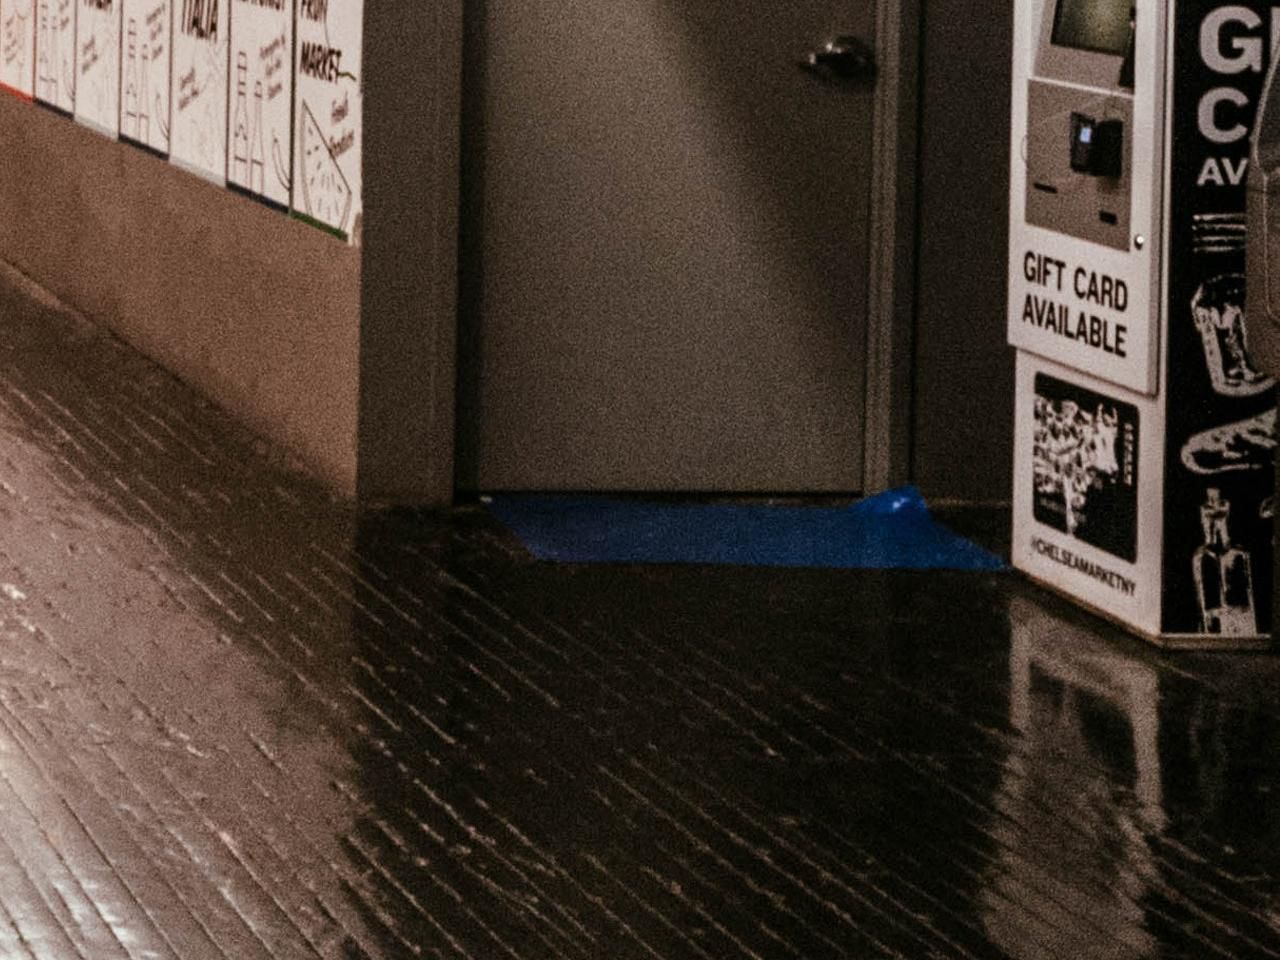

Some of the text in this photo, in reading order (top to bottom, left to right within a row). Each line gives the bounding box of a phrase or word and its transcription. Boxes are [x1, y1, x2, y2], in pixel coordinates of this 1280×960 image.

[300, 40, 343, 83] MARKET
[1023, 250, 1129, 313] GIFT CARD
[1022, 294, 1128, 358] AVAILABLE
